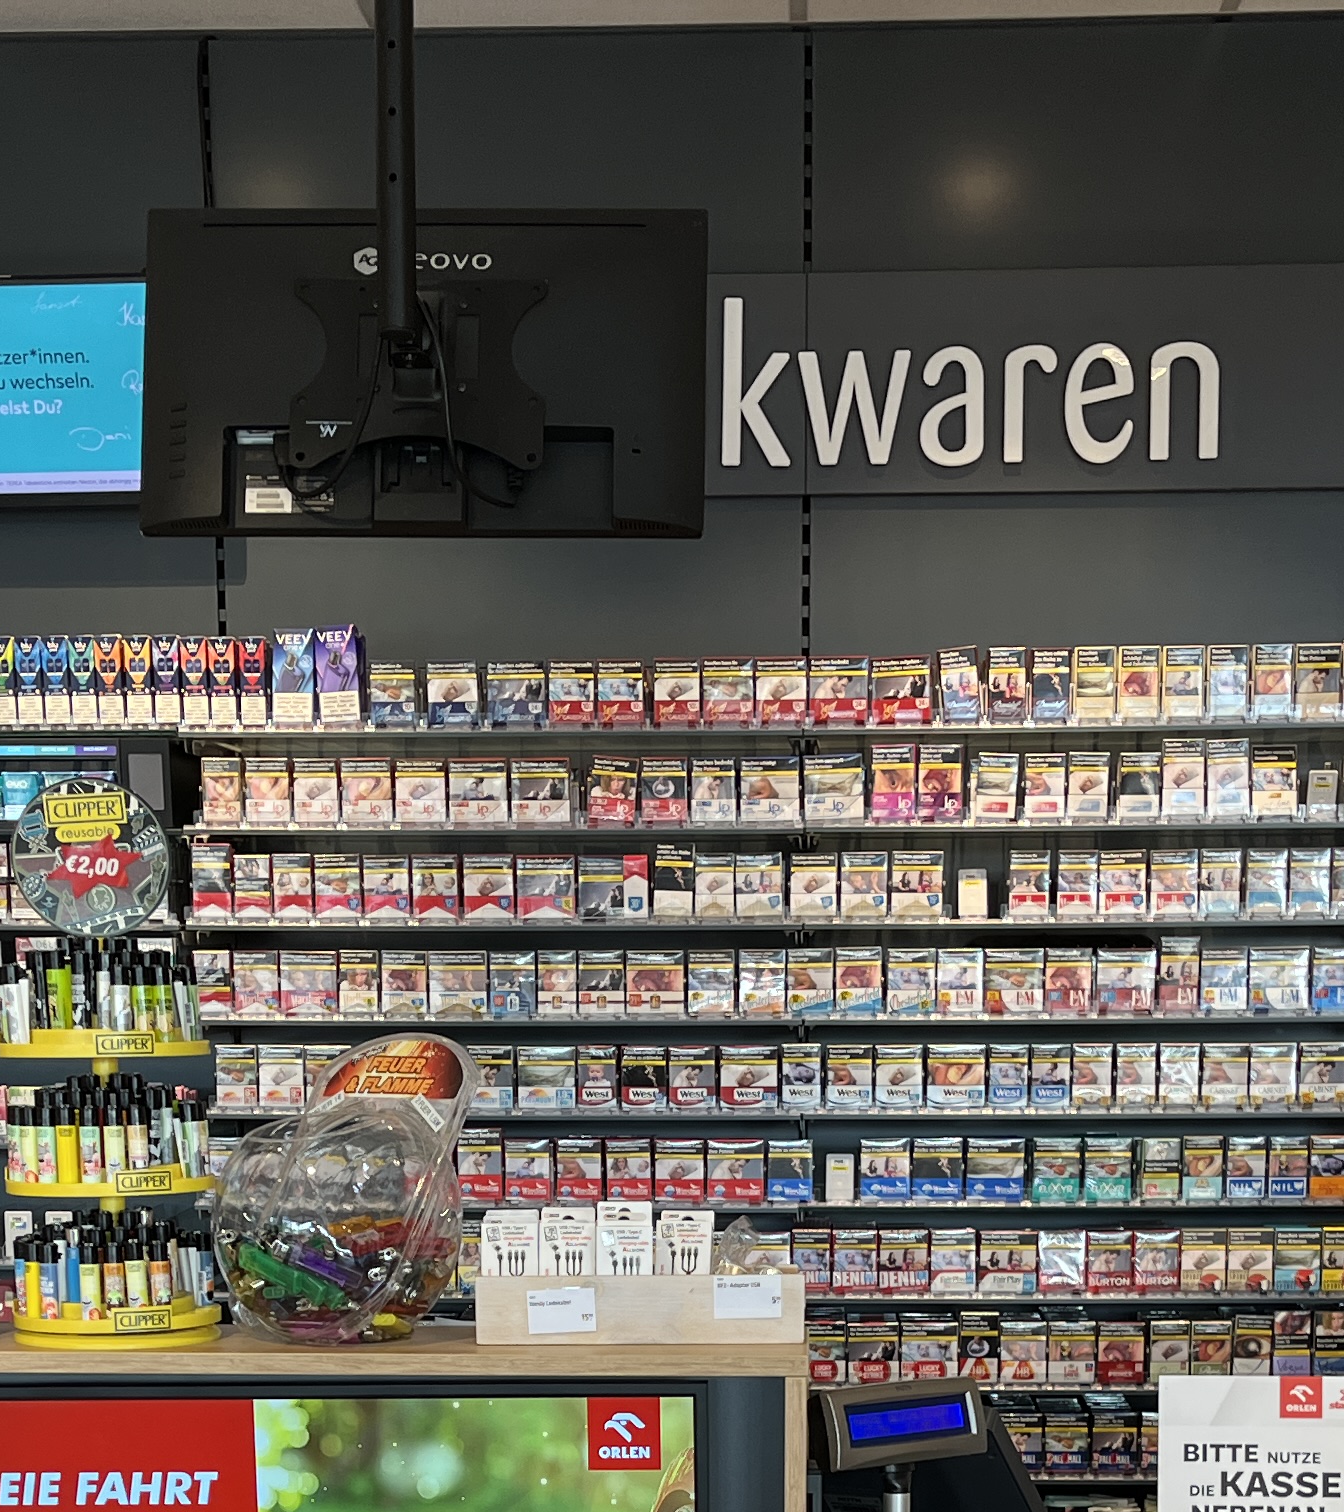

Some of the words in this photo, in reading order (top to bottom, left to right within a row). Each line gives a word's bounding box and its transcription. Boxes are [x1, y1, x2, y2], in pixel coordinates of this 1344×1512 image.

[10, 373, 95, 391] wechseln.
[721, 297, 1220, 467] kwaren
[34, 399, 63, 415] Du?
[53, 799, 117, 818] CLIPPER
[65, 855, 119, 878] €2,00
[99, 1036, 152, 1051] CLIPPER
[366, 1056, 428, 1073] FEUER
[358, 1077, 435, 1094] FLAMME
[1286, 1404, 1317, 1412] ORLEN
[598, 1445, 651, 1459] ORLEN
[1183, 1443, 1259, 1463] BITTE
[1267, 1452, 1321, 1464] NUTZE
[75, 1471, 218, 1506] FAHRT
[1190, 1485, 1214, 1496] DIE
[1221, 1471, 1342, 1498] KASSE
